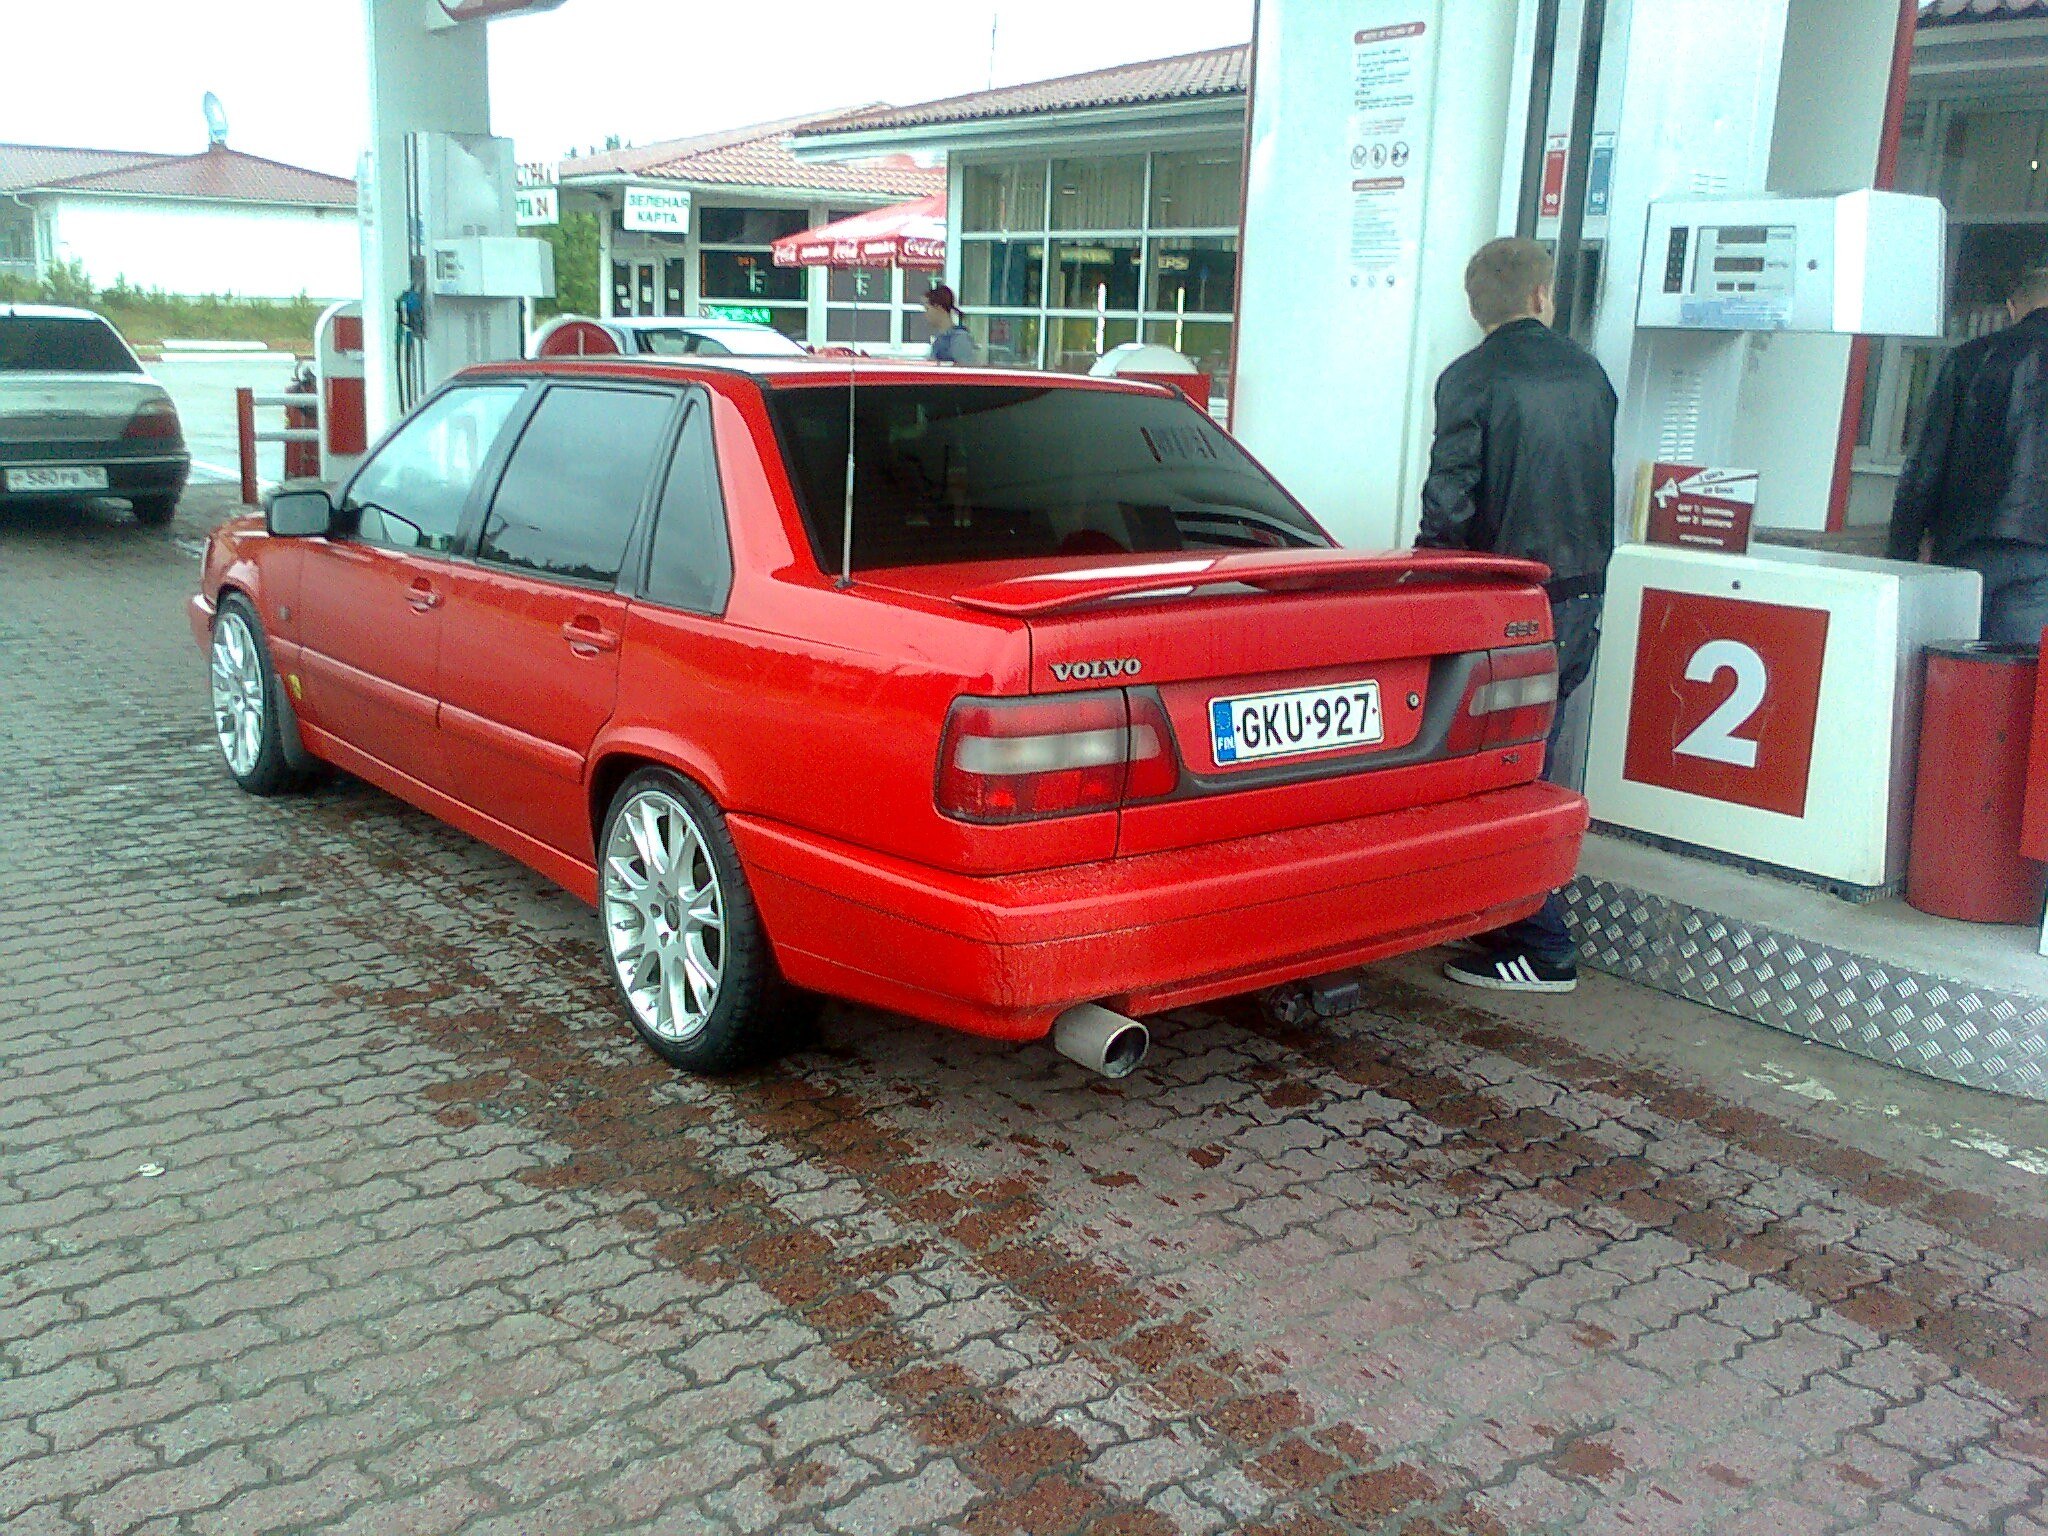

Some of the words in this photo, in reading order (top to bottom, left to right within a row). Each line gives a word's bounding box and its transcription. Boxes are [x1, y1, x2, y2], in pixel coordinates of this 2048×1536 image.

[628, 194, 690, 210] ЗЕЛЕНАЯ
[637, 211, 678, 224] КАРТА
[1049, 658, 1142, 682] VOLVO
[1673, 639, 1767, 768] 2
[1217, 735, 1236, 751] FIN
